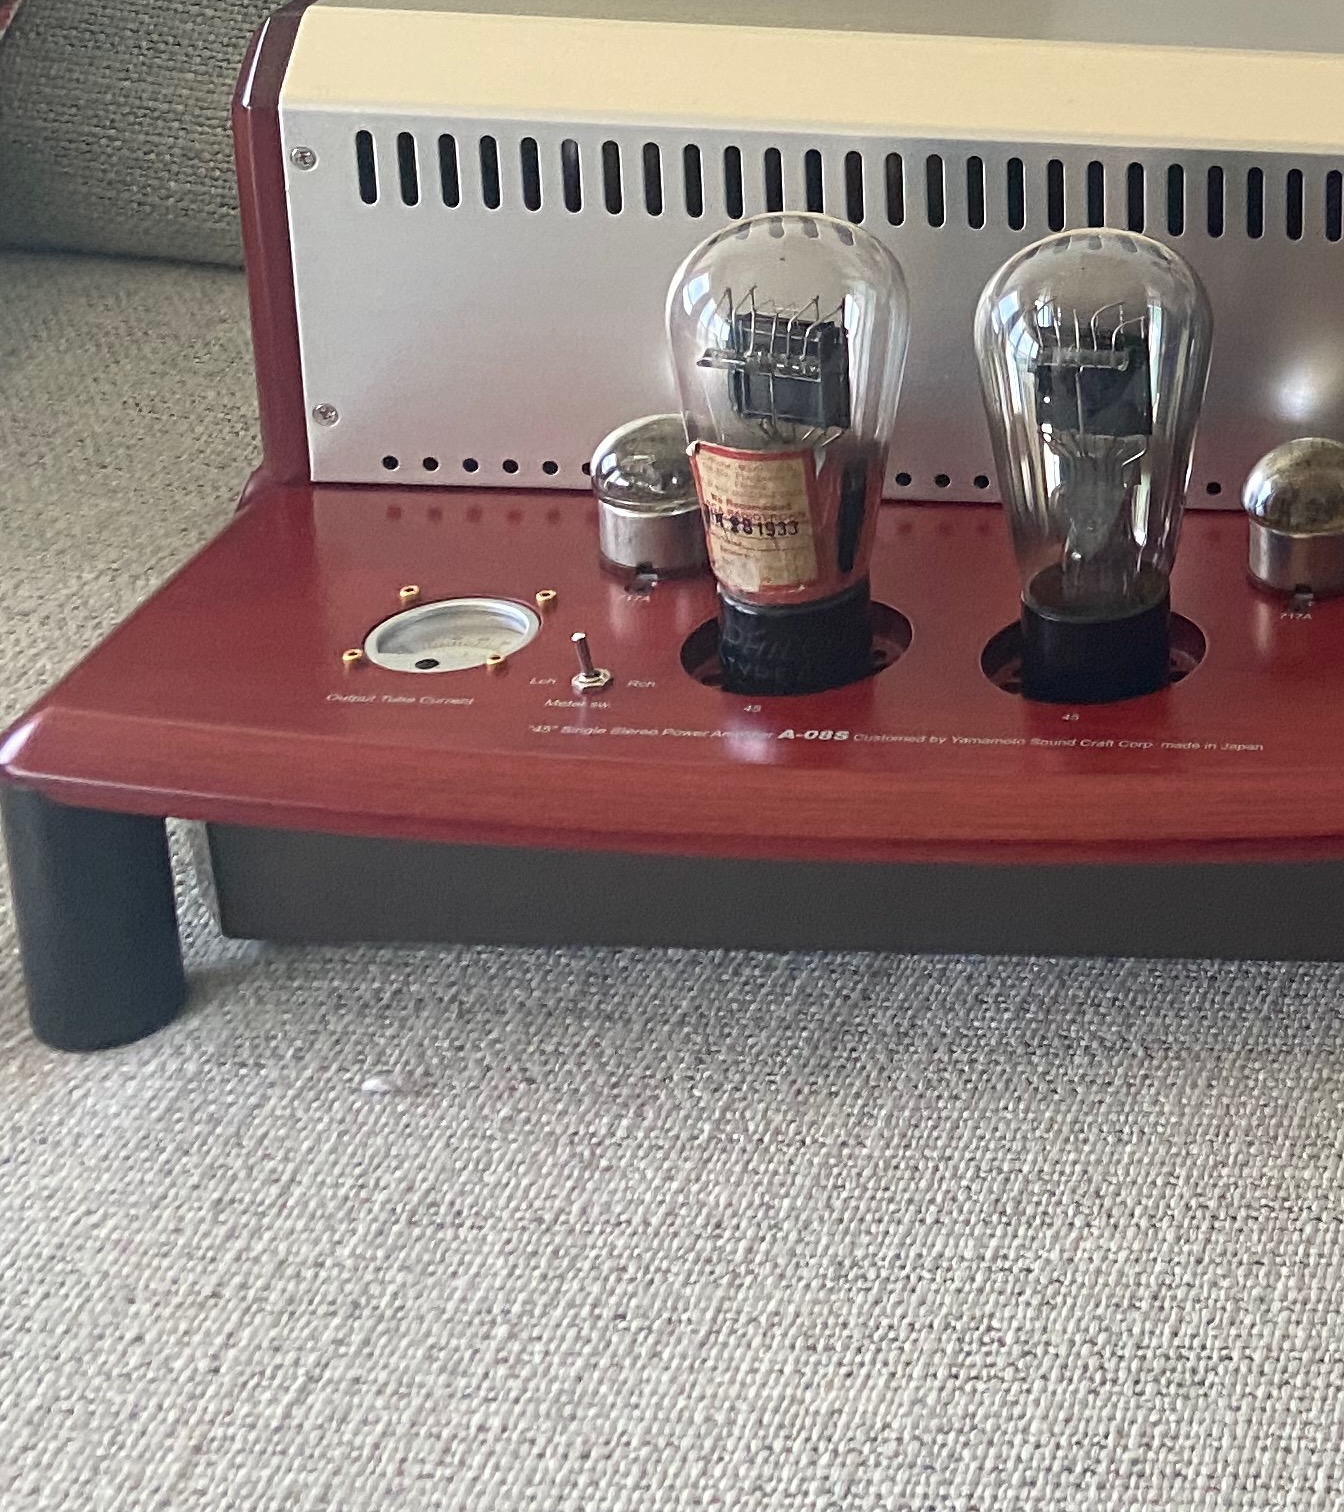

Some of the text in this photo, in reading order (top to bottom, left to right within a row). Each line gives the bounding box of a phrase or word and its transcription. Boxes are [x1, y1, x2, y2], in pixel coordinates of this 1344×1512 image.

[326, 692, 474, 706] Output Tube Current
[560, 726, 608, 736] Single
[609, 727, 659, 736] Stereo
[661, 728, 710, 738] Power
[777, 728, 850, 741] A-08S
[853, 733, 927, 743] Customed
[928, 735, 947, 745] by
[950, 735, 1026, 746] Yamamoto
[1030, 737, 1077, 747] Sound
[1079, 738, 1114, 748] Craft
[1160, 741, 1201, 750] made
[1204, 741, 1217, 750] in
[1220, 742, 1264, 752] Japan
